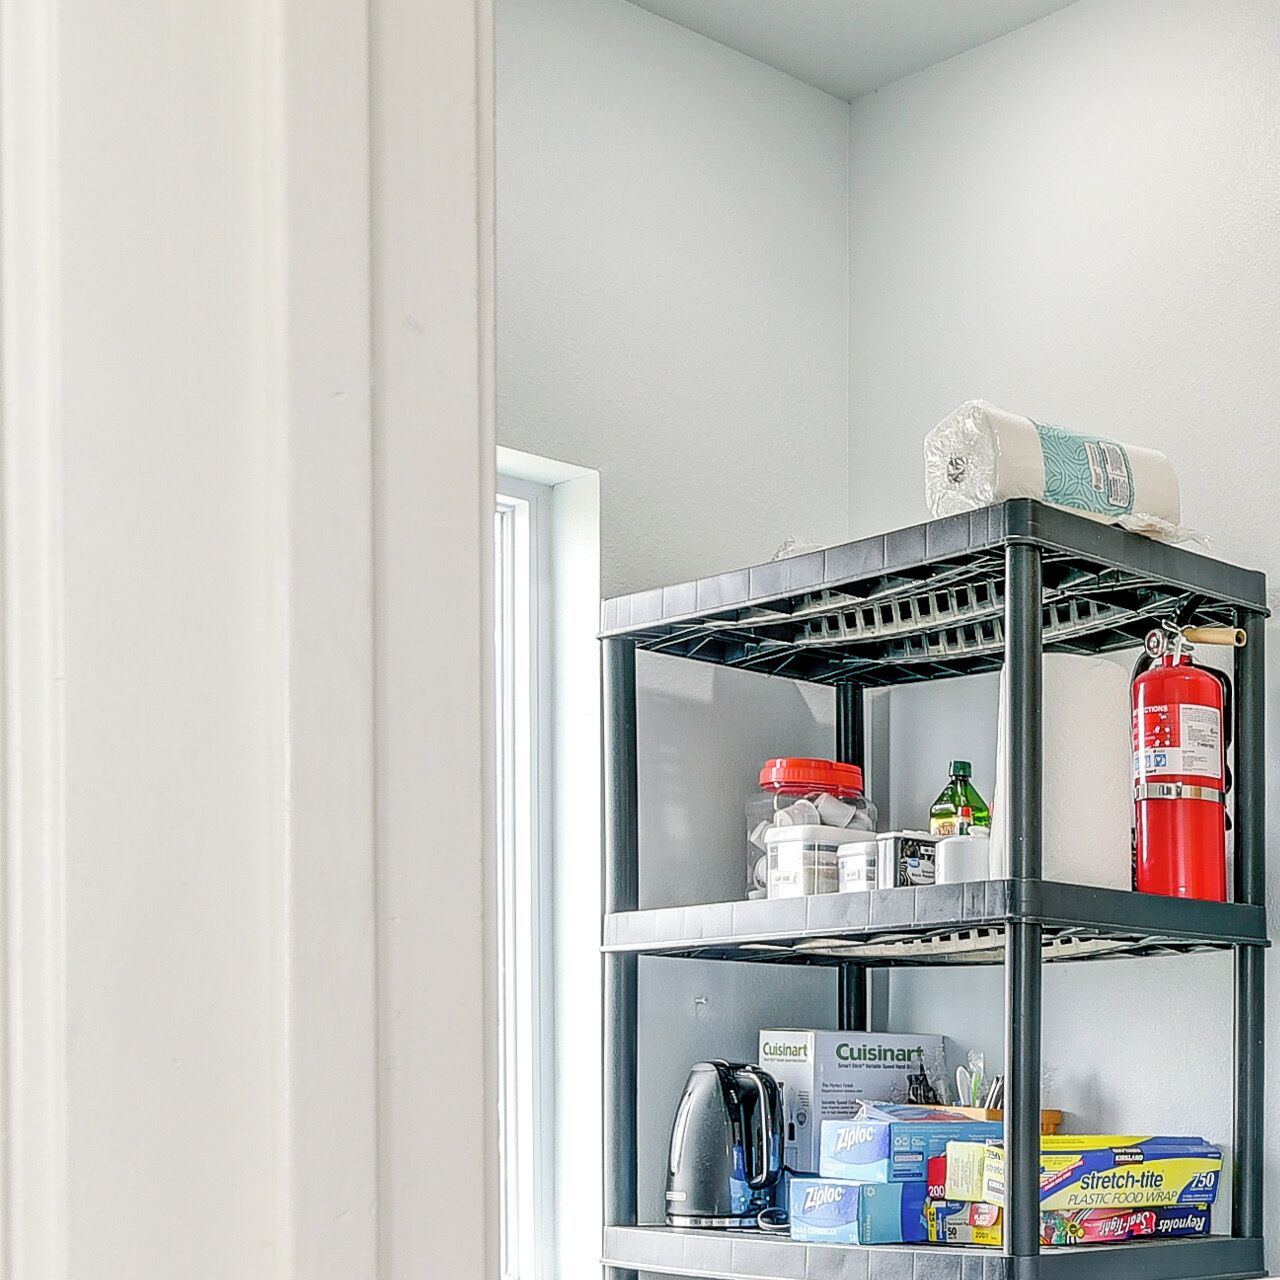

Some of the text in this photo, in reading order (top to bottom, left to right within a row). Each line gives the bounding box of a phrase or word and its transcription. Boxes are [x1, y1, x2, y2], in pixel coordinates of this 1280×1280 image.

[763, 1042, 809, 1057] Cuisinart
[835, 1043, 924, 1062] Cuisinart
[835, 1126, 874, 1151] Ziploc
[1080, 1171, 1164, 1190] stretch-tite
[1191, 1172, 1215, 1187] 750
[803, 1186, 844, 1210] Ziploc
[928, 1185, 945, 1197] 200
[1068, 1191, 1111, 1206] PLASTIC
[1112, 1192, 1144, 1204] FOOD
[1146, 1190, 1177, 1203] WRAP
[947, 1226, 957, 1236] 50
[1158, 1214, 1206, 1233] Reynolds
